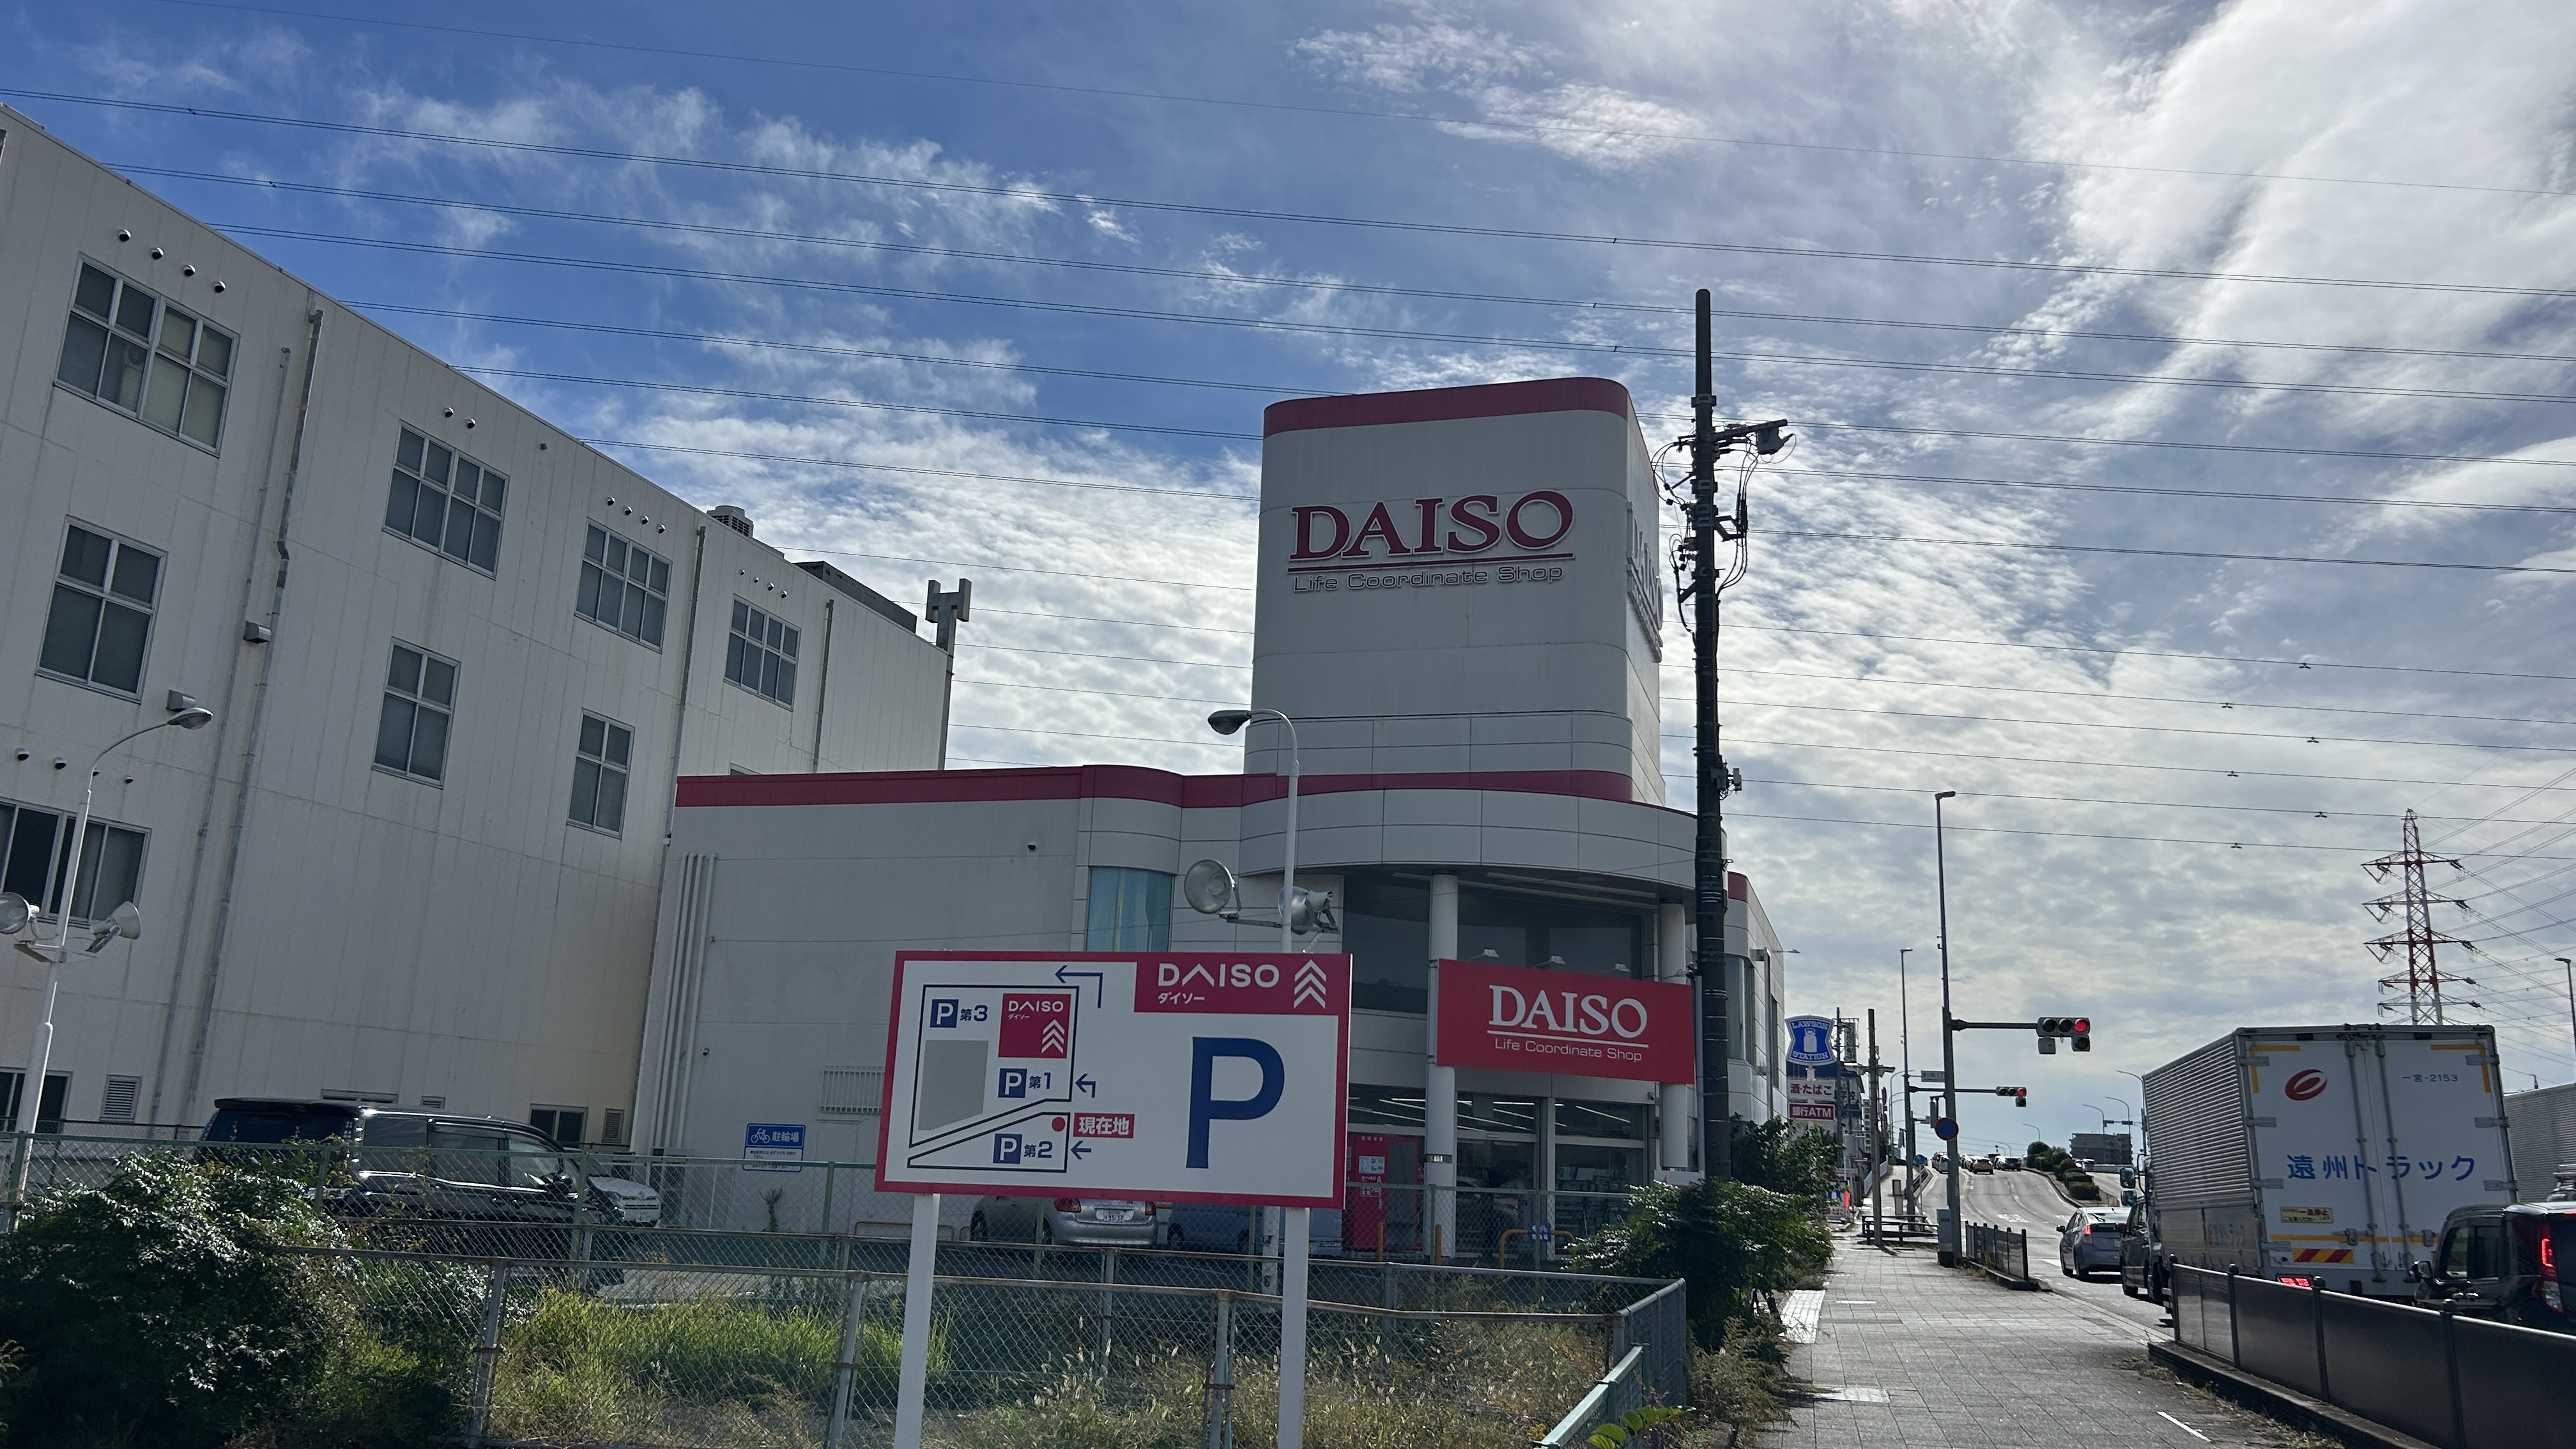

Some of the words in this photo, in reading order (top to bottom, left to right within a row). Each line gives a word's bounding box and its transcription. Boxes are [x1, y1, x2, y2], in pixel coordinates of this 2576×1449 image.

[1289, 489, 1574, 562] DAISO
[1294, 574, 1338, 592] Life
[1347, 570, 1489, 589] Coordinate
[1497, 565, 1563, 583] Shop
[1158, 963, 1280, 988] DAISO
[1008, 1000, 1064, 1013] DAISO
[1157, 992, 1205, 1004] ダイソー
[937, 1003, 954, 1025] P
[960, 1005, 988, 1022] 第3
[1489, 985, 1648, 1038] DAISO
[1791, 1020, 1830, 1030] LAWSON
[1495, 1038, 1521, 1051] Life
[1525, 1041, 1602, 1058] Coordinate
[1607, 1047, 1643, 1063] Shop
[1792, 1051, 1829, 1061] STATION
[1004, 1072, 1022, 1095] P
[1029, 1072, 1051, 1089] 第1
[1185, 1036, 1285, 1169] P
[1792, 1106, 1832, 1118] 銀行ATM
[772, 1131, 799, 1142] 駐輪場
[1078, 1116, 1130, 1135] 現在地
[1000, 1137, 1017, 1161] P
[1023, 1141, 1053, 1158] 第2
[2287, 1154, 2474, 1181] 遠州トラック
